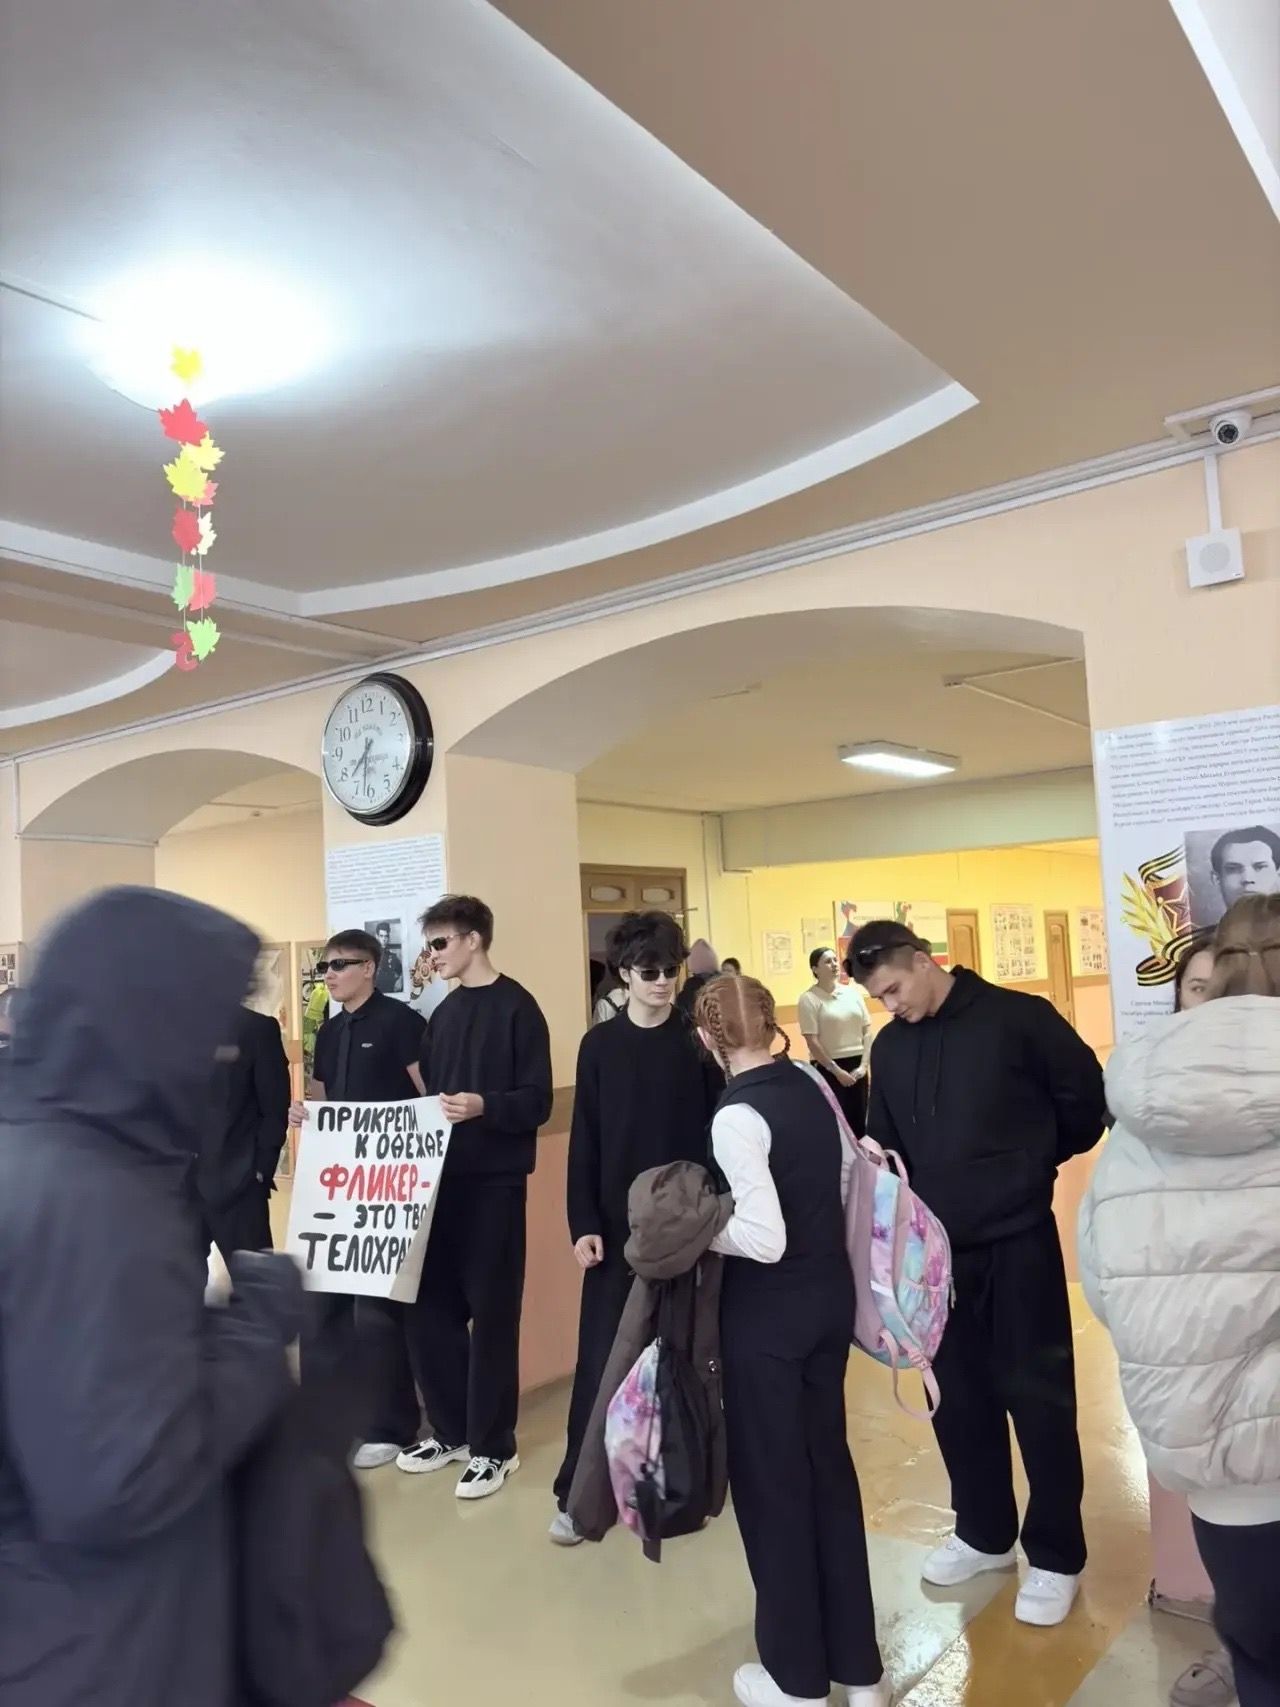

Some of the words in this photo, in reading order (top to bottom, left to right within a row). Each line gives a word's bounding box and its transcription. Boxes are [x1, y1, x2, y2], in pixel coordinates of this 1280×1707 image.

[361, 697, 374, 714] 12
[348, 708, 359, 723] 11
[389, 711, 398, 727] 2
[339, 726, 351, 742] 10
[335, 746, 343, 762] 9
[341, 767, 349, 782] 8
[383, 774, 391, 790] 5
[353, 780, 361, 796] 7
[366, 783, 375, 798] 6
[317, 1104, 419, 1133] ПРИКРЕПИ
[355, 1134, 369, 1159] К
[353, 1203, 396, 1230] ЭТО
